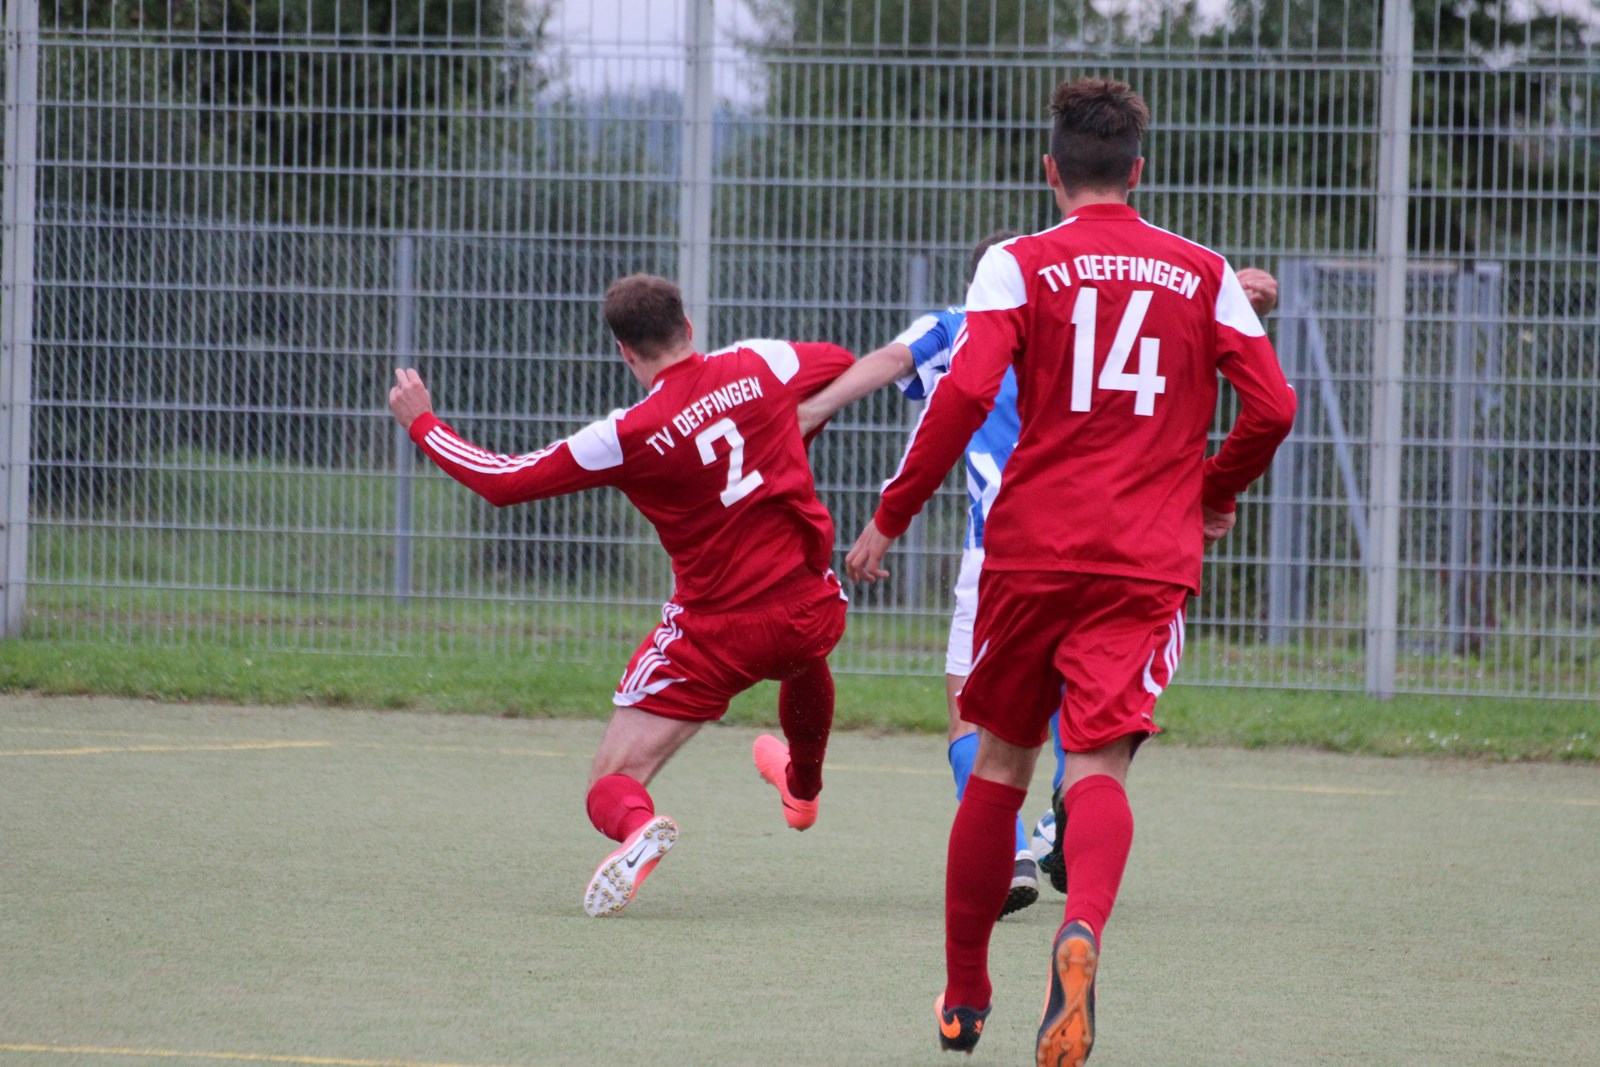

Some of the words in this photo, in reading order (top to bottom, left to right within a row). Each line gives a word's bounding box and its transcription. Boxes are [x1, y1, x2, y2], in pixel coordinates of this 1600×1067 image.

[1038, 262, 1072, 293] TV
[1073, 254, 1202, 300] OEFFINGEN
[1070, 286, 1167, 417] 14
[645, 426, 676, 456] TV
[672, 376, 764, 437] OEFFINGEN
[694, 417, 764, 508] 2
